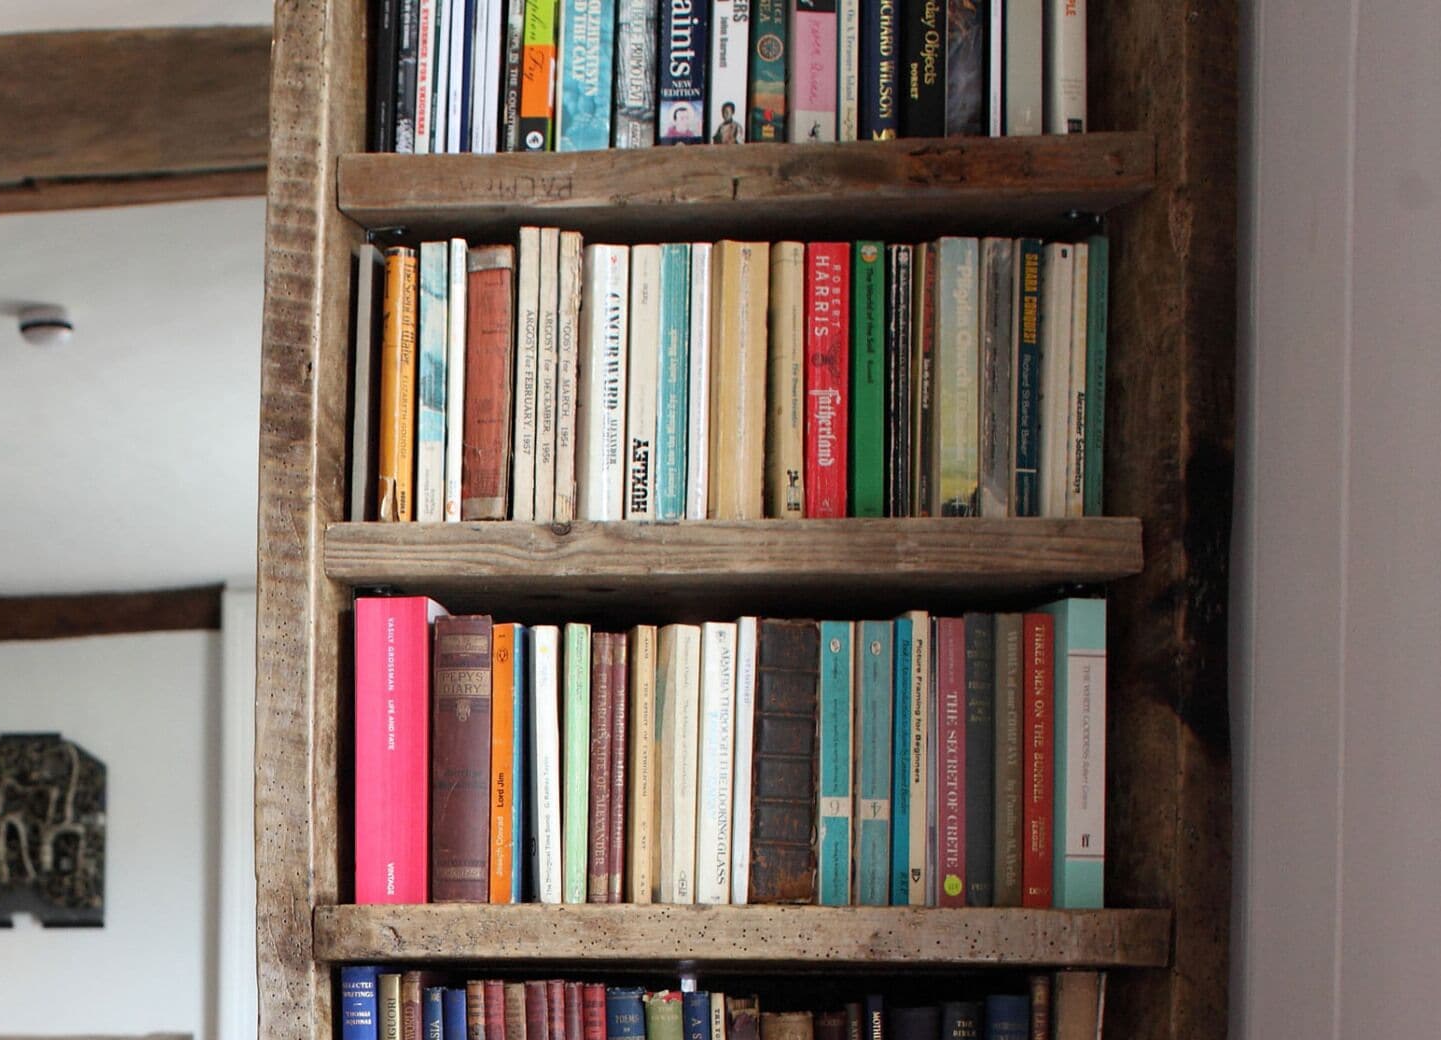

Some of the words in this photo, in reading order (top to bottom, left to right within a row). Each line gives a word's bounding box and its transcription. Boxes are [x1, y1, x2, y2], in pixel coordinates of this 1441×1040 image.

[573, 15, 587, 42] THE
[523, 48, 544, 80] Fry
[572, 46, 586, 80] CALF
[630, 42, 643, 77] PRIMO
[921, 31, 940, 85] Objects
[508, 68, 518, 86] THE
[629, 78, 642, 103] LEVI
[672, 80, 692, 88] NEW
[878, 61, 893, 118] WILSON
[1023, 253, 1038, 291] SAHARA
[814, 255, 830, 337] HARRIS
[831, 264, 841, 328] ROBERT
[952, 265, 974, 326] Pilgrim
[402, 315, 414, 327] of
[524, 309, 535, 354] ARGOSY
[543, 311, 554, 353] ARGOSY
[1023, 296, 1037, 344] CONQUEST
[524, 354, 534, 369] for
[543, 359, 553, 372] for
[561, 359, 571, 372] for
[956, 330, 973, 387] Church
[809, 387, 842, 467] Fatherland
[1075, 391, 1085, 435] Alexander
[522, 433, 532, 455] 1957
[541, 442, 551, 465] 1956
[560, 426, 570, 448] 1954
[631, 438, 650, 513] HUXLEY
[386, 617, 395, 643] VASILY
[1034, 624, 1045, 665] THREE
[386, 646, 395, 692] GROSSMAN
[719, 647, 731, 690] ARABIA
[915, 638, 923, 673] Picture
[442, 684, 482, 694] DIARY
[913, 675, 923, 715] Framing
[1034, 669, 1045, 696] MEN
[387, 699, 396, 714] LIFE
[718, 690, 730, 757] THROUGH
[946, 691, 957, 725] THE
[1034, 700, 1045, 718] ON
[387, 716, 396, 732] AND
[914, 718, 922, 732] for
[1033, 723, 1044, 748] THE
[387, 733, 396, 751] FATE
[596, 744, 607, 771] LIFE
[912, 734, 922, 784] Beginners
[946, 730, 957, 788] SECRET
[496, 772, 505, 789] Jim
[596, 776, 607, 790] OF
[717, 759, 729, 784] THE
[1032, 751, 1044, 803] BUMMEL
[496, 790, 505, 808] Lord
[717, 786, 729, 841] LOOKING
[946, 791, 957, 809] OF
[595, 795, 607, 865] ALEXANDER
[946, 814, 958, 868] CRETE
[386, 862, 395, 896] VINTAGE
[716, 842, 727, 885] GLASS
[691, 1018, 702, 1026] A
